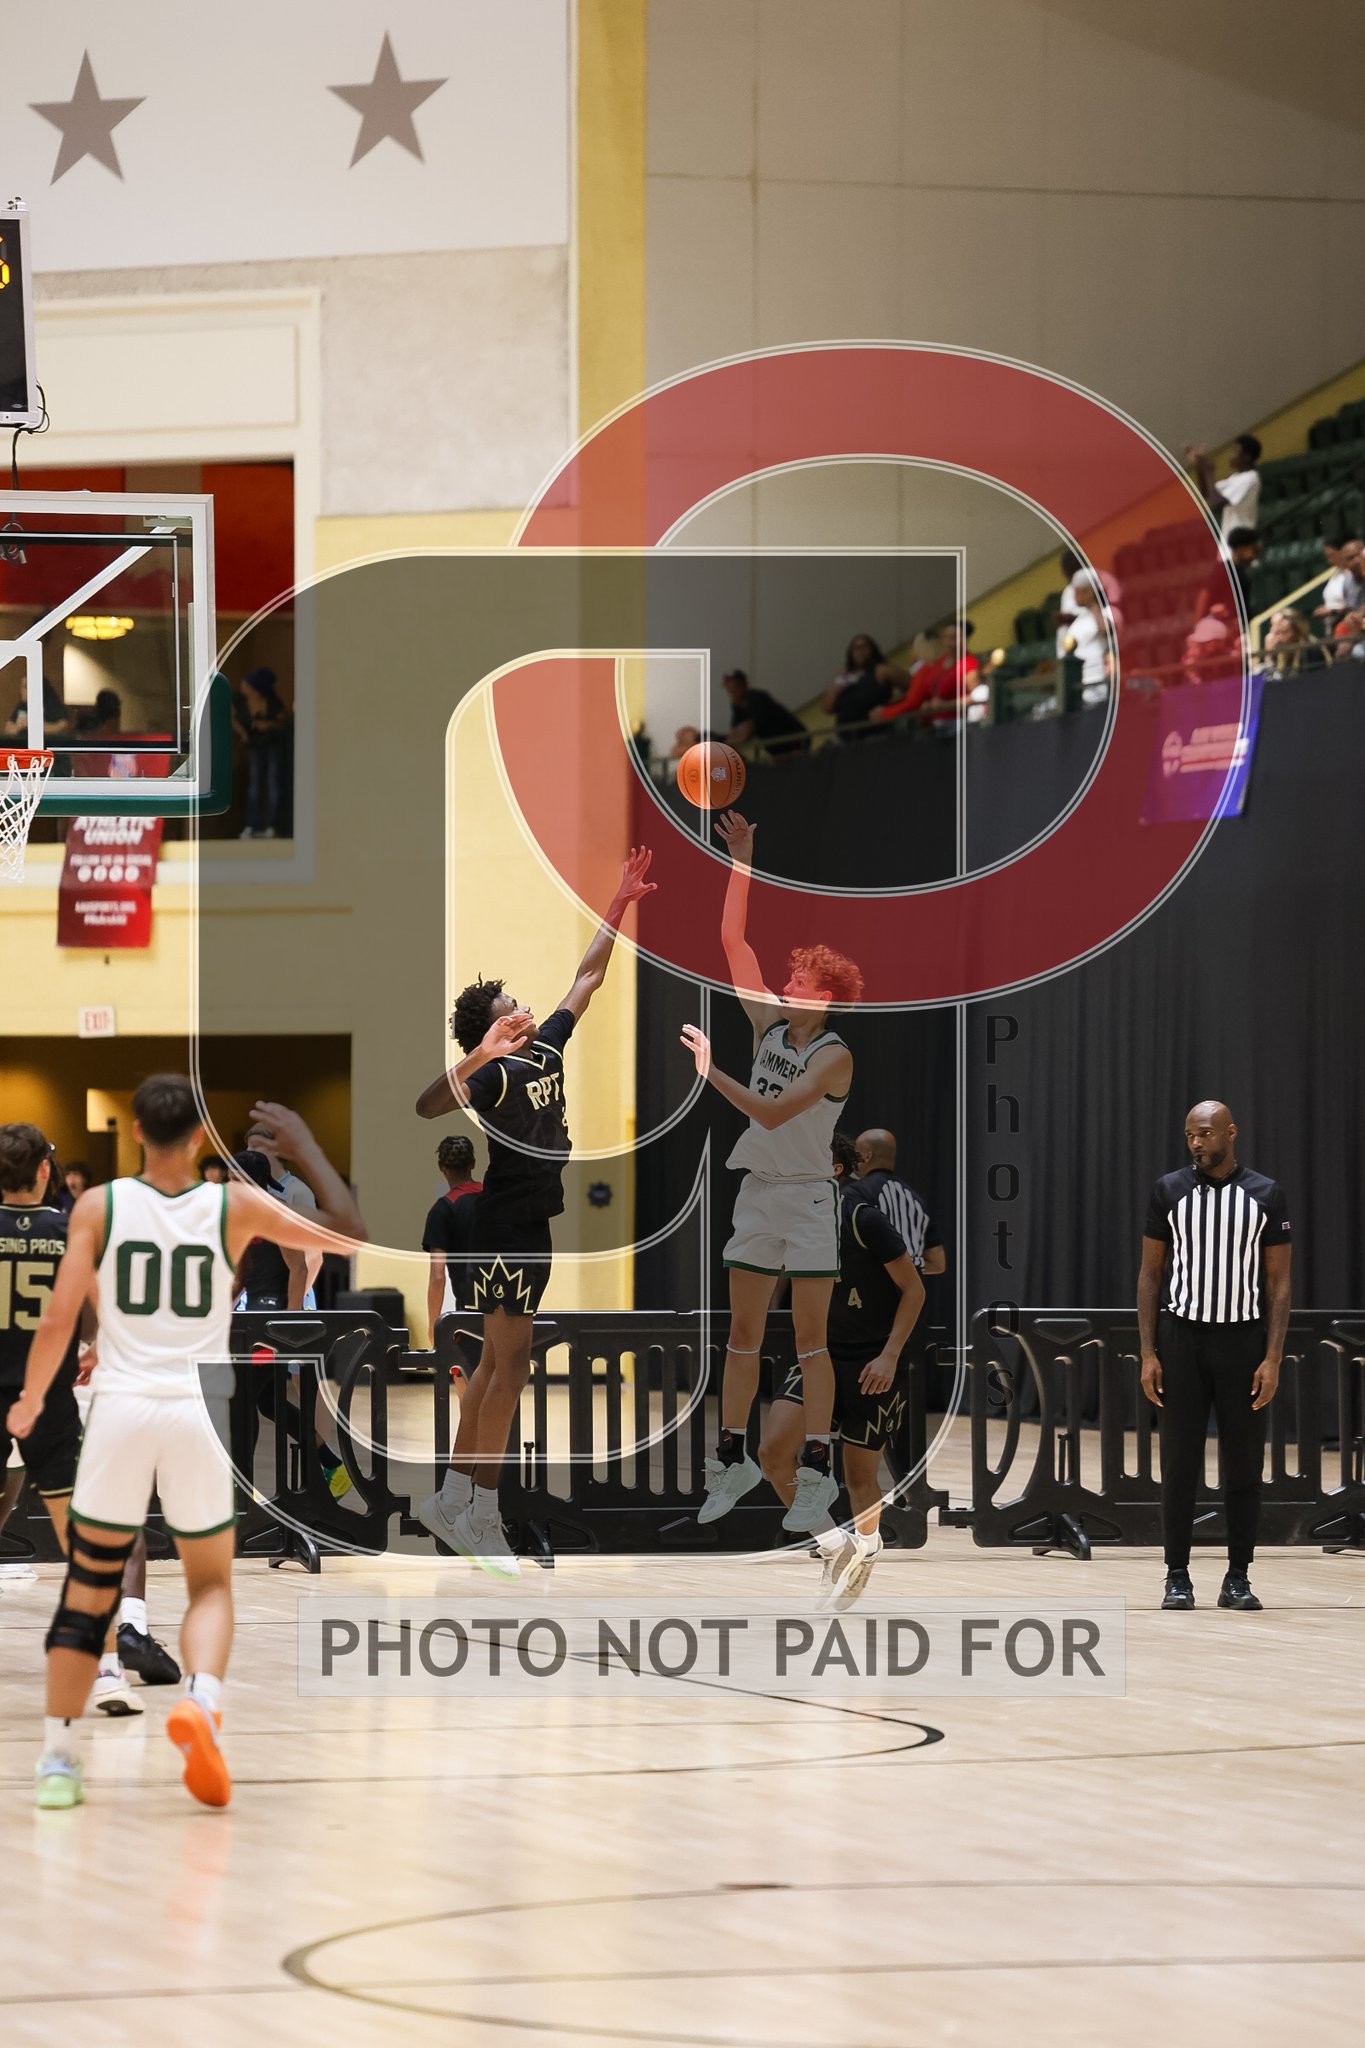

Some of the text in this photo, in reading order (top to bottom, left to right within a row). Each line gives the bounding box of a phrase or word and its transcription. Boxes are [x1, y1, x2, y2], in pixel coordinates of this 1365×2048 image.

[84, 829, 144, 846] UNION
[85, 1011, 110, 1031] EXIT
[525, 1072, 560, 1110] RPT
[30, 1239, 66, 1255] PROS
[116, 1240, 214, 1318] 00
[0, 1261, 55, 1330] 15
[847, 1287, 863, 1309] 4
